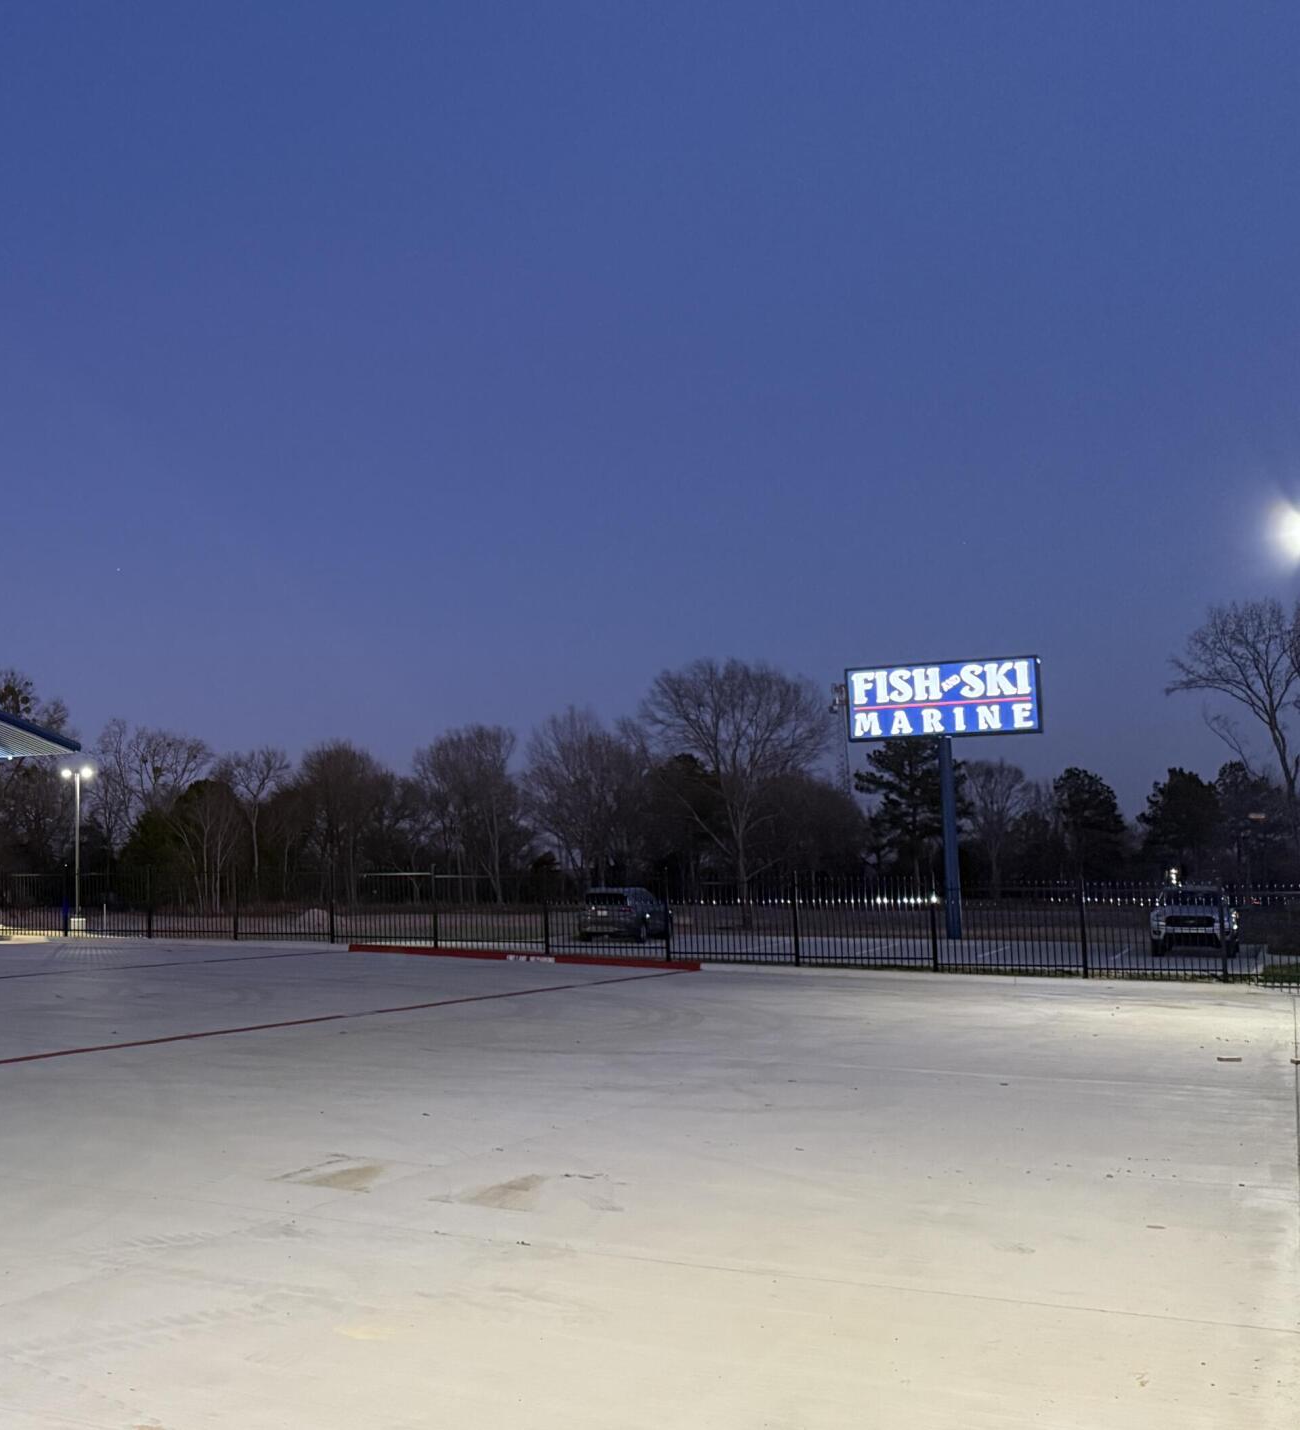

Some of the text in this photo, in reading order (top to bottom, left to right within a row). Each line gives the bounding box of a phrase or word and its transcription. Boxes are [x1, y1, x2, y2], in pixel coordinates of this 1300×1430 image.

[851, 667, 942, 704] FISH
[959, 661, 1032, 698] SKI
[854, 703, 1034, 737] MARINE
